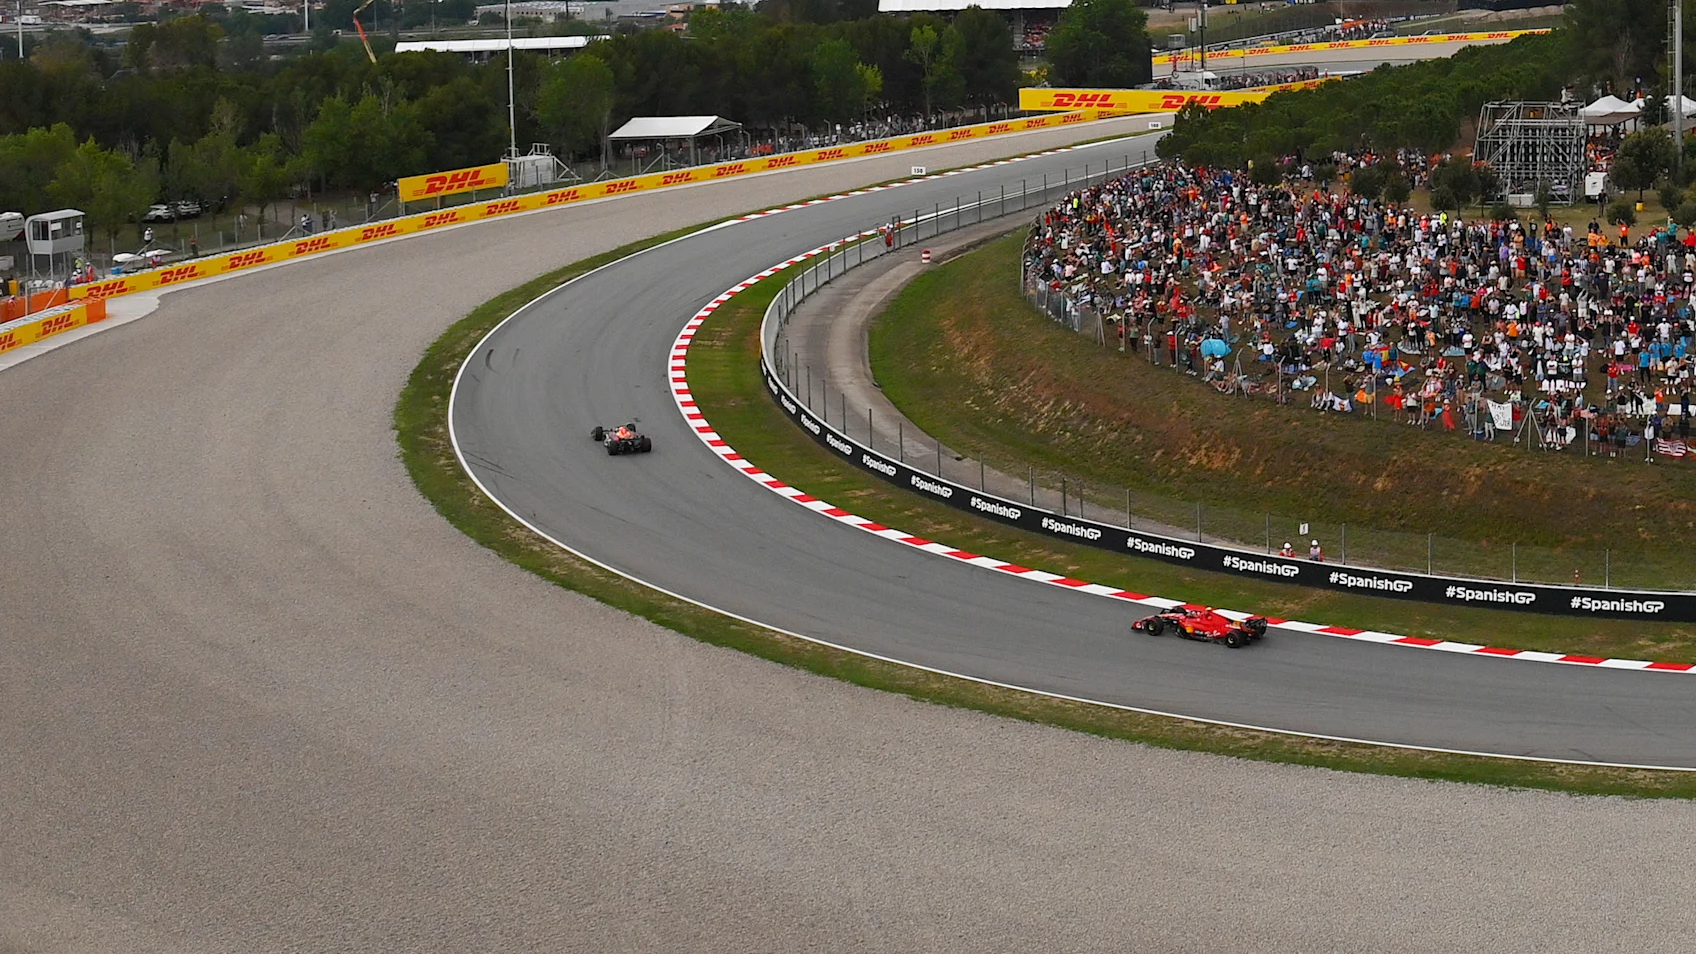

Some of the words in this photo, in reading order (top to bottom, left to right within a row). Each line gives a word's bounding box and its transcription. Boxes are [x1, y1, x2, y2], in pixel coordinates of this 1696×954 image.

[1207, 51, 1231, 59] DHL
[1053, 93, 1116, 108] DHL
[1161, 95, 1223, 110] DHL
[1025, 118, 1047, 129] DHL
[1062, 113, 1083, 124] DHL
[950, 129, 973, 140] DHL
[988, 123, 1011, 134] DHL
[864, 142, 890, 154] DHL
[911, 135, 934, 147] DHL
[767, 156, 796, 168] DHL
[817, 148, 844, 161] DHL
[662, 172, 692, 185] DHL
[716, 164, 745, 177] DHL
[424, 169, 486, 195] DHL
[605, 180, 637, 194] DHL
[546, 189, 580, 204] DHL
[486, 200, 520, 216] DHL
[424, 211, 458, 228] DHL
[361, 223, 397, 240] DHL
[295, 237, 331, 255] DHL
[229, 251, 265, 269] DHL
[160, 264, 201, 284] DHL
[86, 280, 128, 298] DHL
[41, 313, 75, 336] DHL
[0, 333, 16, 350] HL
[863, 454, 896, 476] #SpanishGP
[911, 475, 952, 498] #SpanishGP
[971, 497, 1021, 519] #SpanishGP
[1042, 518, 1101, 540] #SpanishGP
[1127, 537, 1194, 559] #SpanishGP
[1223, 556, 1299, 577] #SpanishGP
[1329, 571, 1413, 593] #SpanishGP
[1446, 586, 1536, 605] #SpanishGP
[1571, 597, 1665, 613] #SpanishGP
